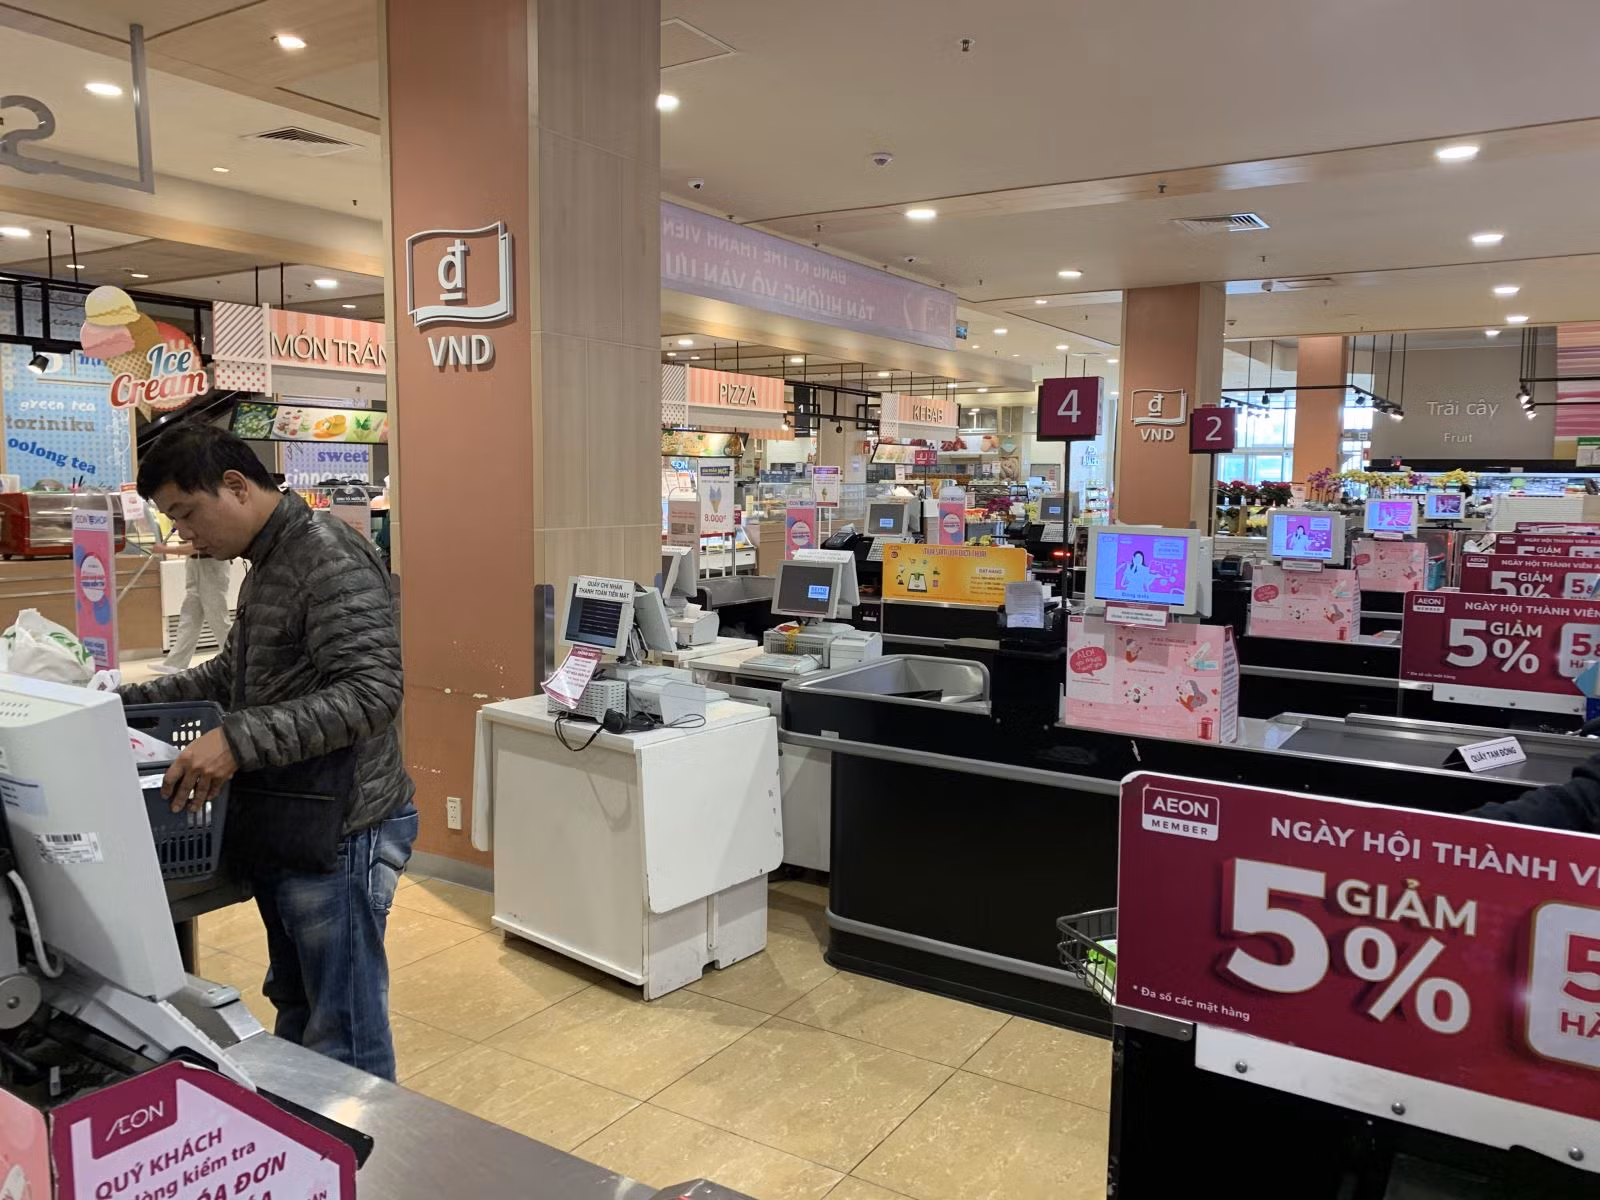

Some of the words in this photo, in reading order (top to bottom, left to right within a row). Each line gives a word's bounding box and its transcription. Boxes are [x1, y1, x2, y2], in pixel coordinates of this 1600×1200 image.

[270, 329, 328, 361] MÓN
[428, 334, 495, 368] VND
[147, 344, 192, 378] Ice
[110, 367, 209, 409] Cream
[718, 382, 757, 407] PIZZA
[19, 399, 65, 414] green
[71, 399, 96, 412] tea
[912, 404, 944, 423] KEBAB
[1057, 389, 1082, 423] 4
[1426, 400, 1460, 416] Trái
[1466, 399, 1499, 418] cây
[6, 415, 95, 433] toriniku
[1140, 428, 1175, 442] VND
[1205, 416, 1222, 441] 2
[1444, 433, 1473, 443] Fruit
[8, 436, 69, 475] oolong
[71, 456, 96, 475] tea
[317, 450, 369, 463] sweet
[1525, 559, 1540, 568] HỘI
[1518, 571, 1553, 583] GIẢM
[1417, 597, 1441, 605] AEON
[1465, 600, 1498, 611] NGÀY
[1501, 602, 1522, 614] HỘI
[1526, 603, 1569, 616] THÀNH
[1490, 620, 1543, 638] GIẢM
[1153, 795, 1210, 818] AEON
[1151, 818, 1209, 836] MEMBER
[1270, 816, 1355, 849] NGÀY
[1364, 831, 1421, 863] HỘI
[1433, 841, 1556, 882] THÀNH
[1336, 879, 1477, 936] GIẢM
[1141, 985, 1156, 1000] Đa
[1159, 988, 1172, 1003] số
[1174, 994, 1193, 1008] các
[1196, 999, 1219, 1015] mặt
[1221, 1003, 1251, 1022] hàng
[95, 1161, 144, 1200] QUÝ
[150, 1127, 222, 1177] KHÁCH
[183, 1155, 228, 1187] kiểm
[231, 1141, 256, 1162] tra
[196, 1184, 227, 1200] ÓA
[234, 1151, 287, 1195] ĐƠN
